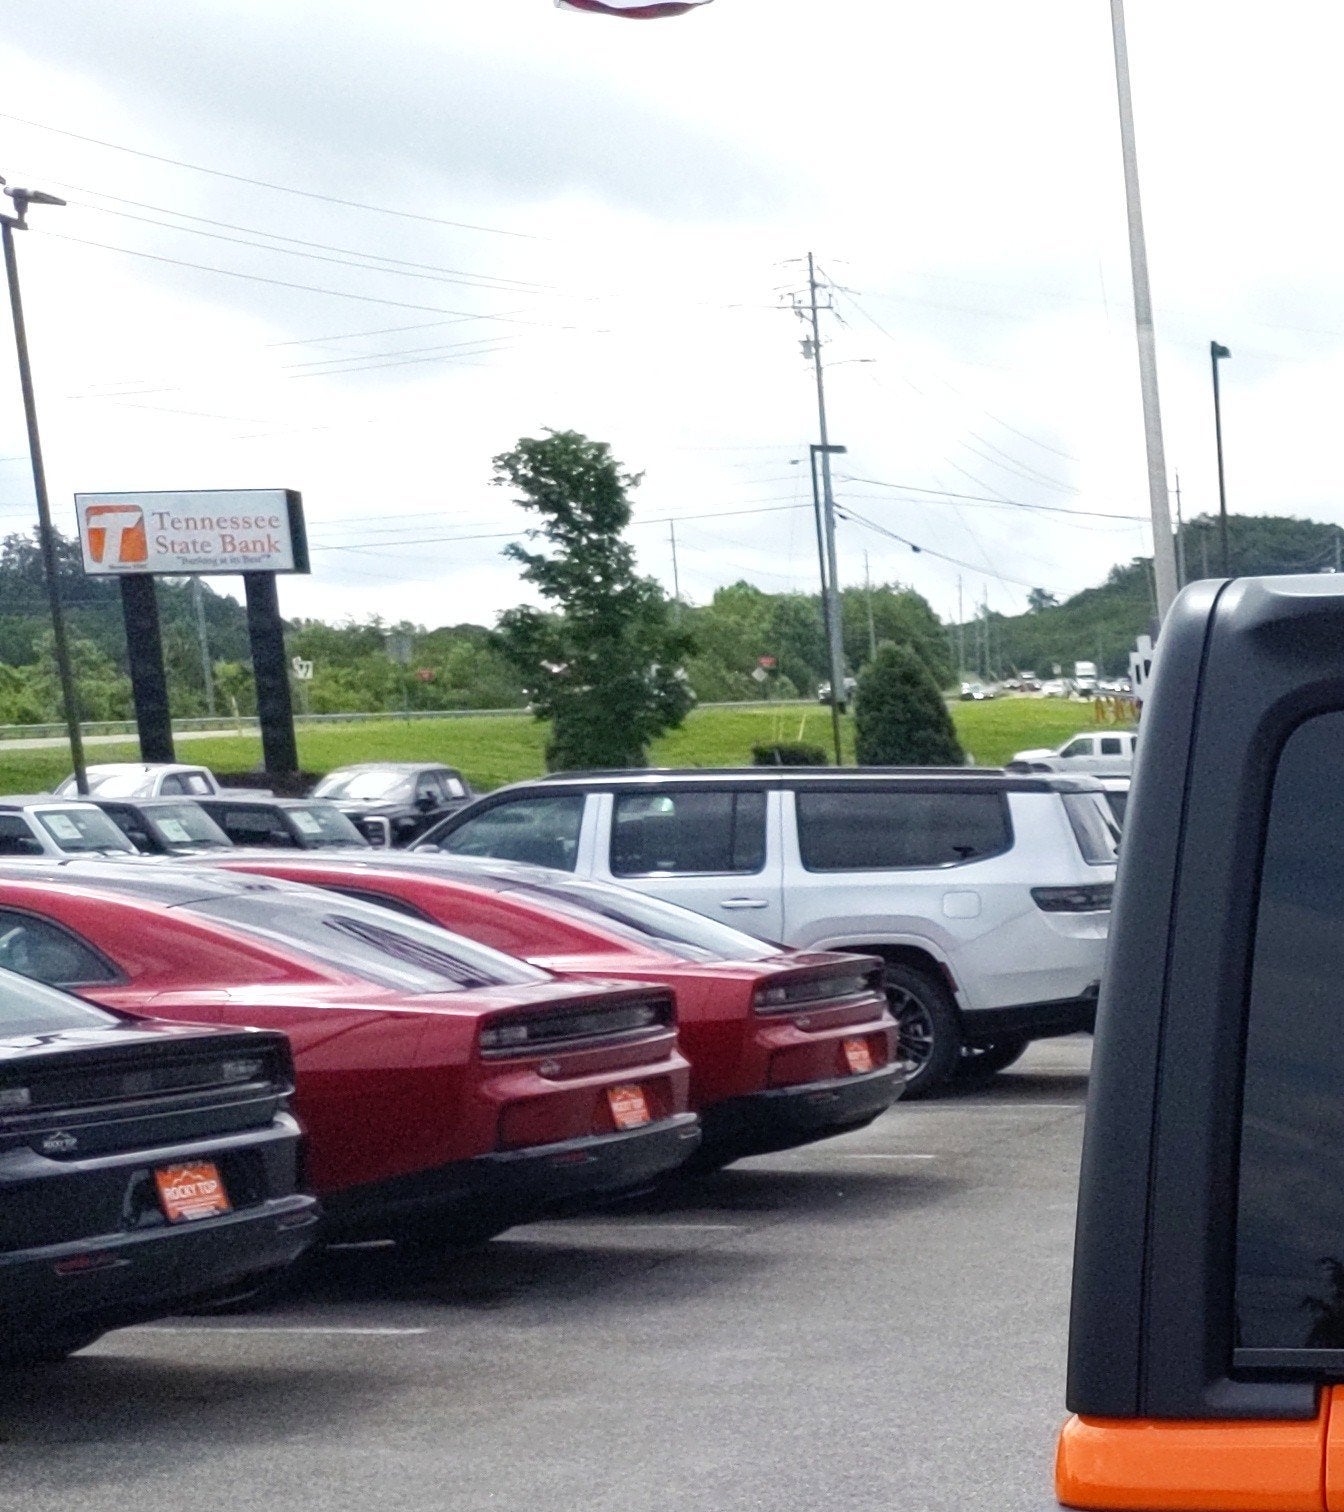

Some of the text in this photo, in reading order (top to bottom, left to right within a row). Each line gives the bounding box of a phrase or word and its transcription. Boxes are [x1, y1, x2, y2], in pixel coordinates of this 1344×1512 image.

[152, 511, 281, 531] Tennessee
[155, 533, 281, 554] State Bank
